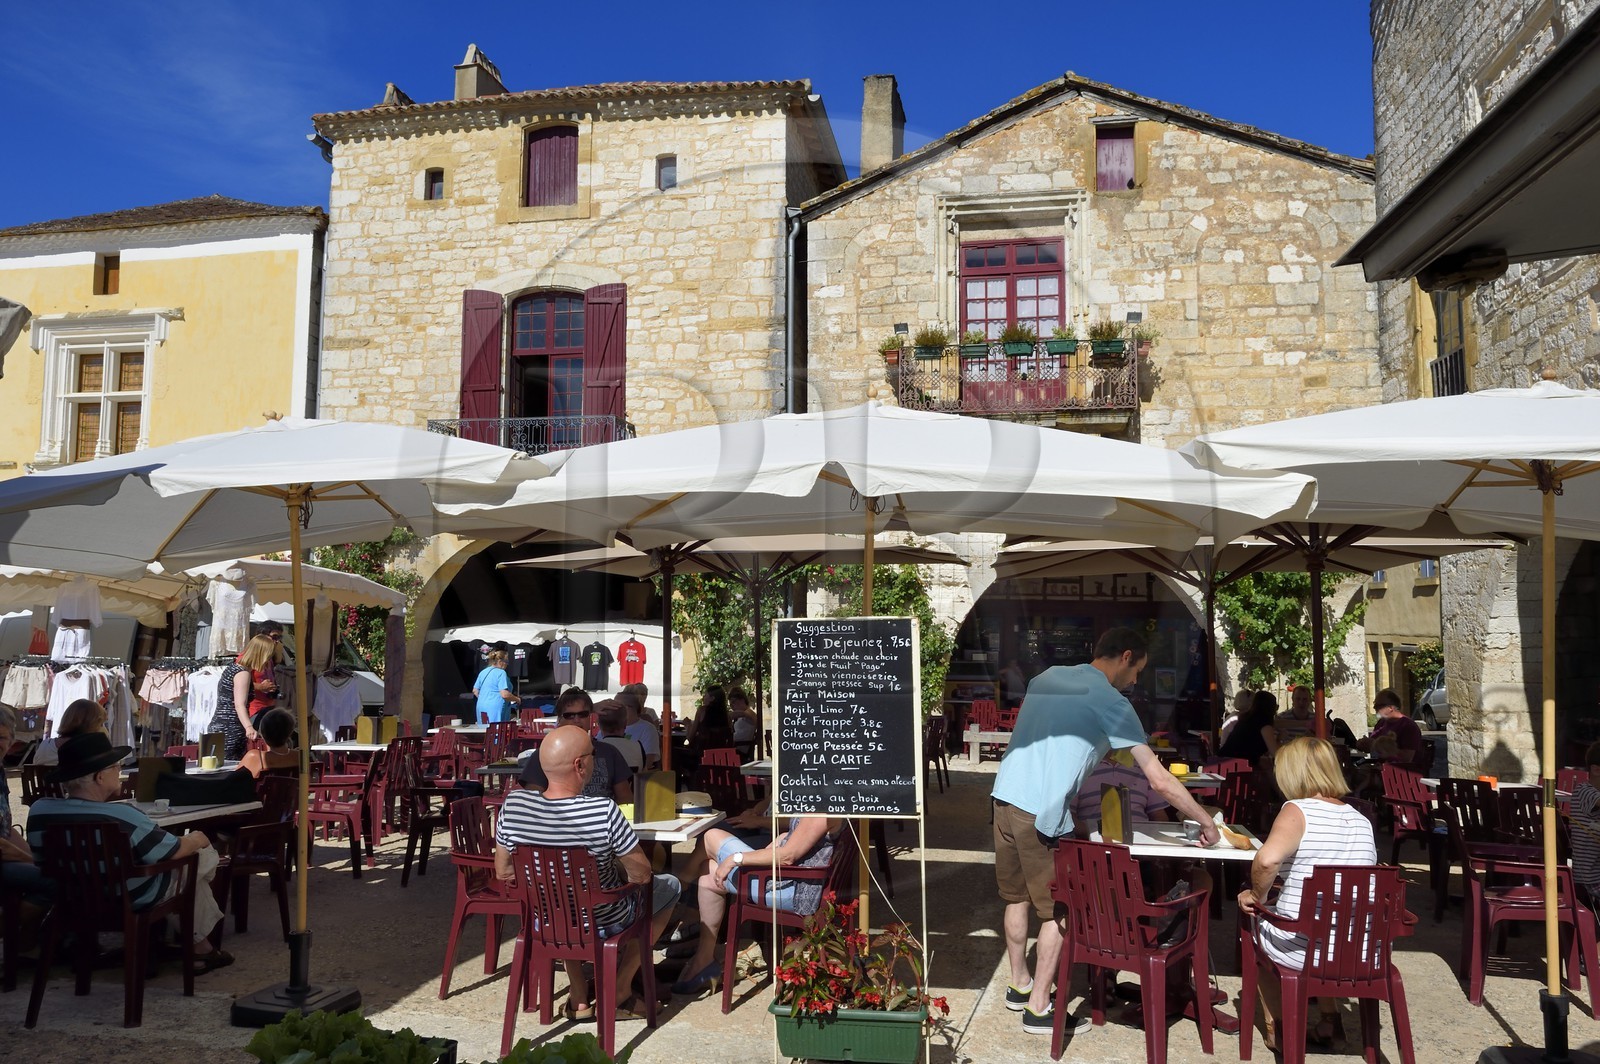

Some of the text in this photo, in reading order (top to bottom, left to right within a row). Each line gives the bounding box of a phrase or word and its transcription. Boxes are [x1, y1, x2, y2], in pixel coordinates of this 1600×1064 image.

[783, 638, 816, 650] Petit
[785, 703, 814, 717] Mojito
[821, 705, 843, 713] Limo
[783, 717, 807, 726] Café
[813, 716, 853, 730] Frappé
[783, 729, 816, 738] Citron
[823, 729, 857, 739] Pressé
[781, 741, 819, 753] Orange
[800, 755, 872, 765] A LA CARTE
[781, 774, 828, 786] Cocktail
[780, 790, 821, 802] Glaces
[851, 792, 879, 803] choix
